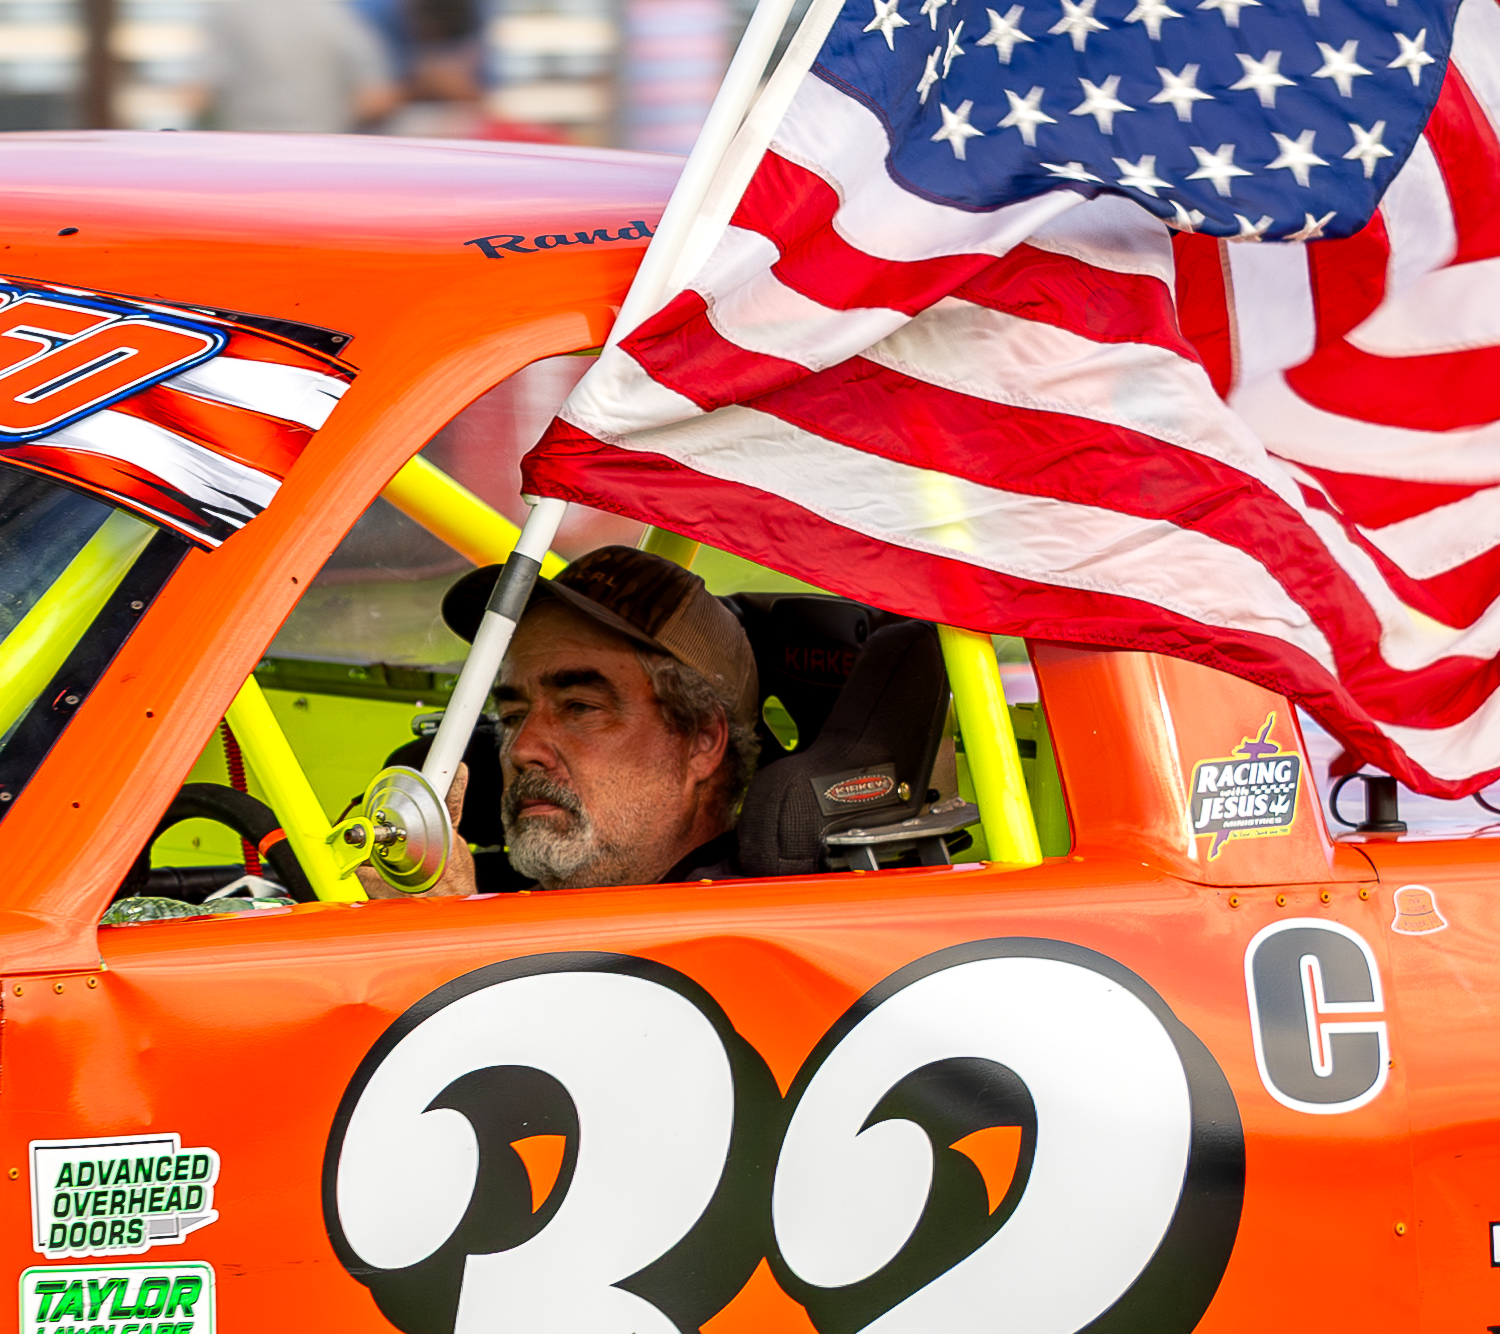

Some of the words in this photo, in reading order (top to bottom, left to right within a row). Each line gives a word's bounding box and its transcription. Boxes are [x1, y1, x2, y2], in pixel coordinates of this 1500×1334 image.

[463, 220, 660, 259] Rand
[784, 646, 855, 677] KIRKE
[1196, 759, 1292, 794] RACING
[1219, 786, 1250, 798] with
[1194, 793, 1269, 829] JESUS
[1222, 816, 1283, 829] MINISTRIES
[1244, 918, 1389, 1114] C
[54, 1153, 211, 1189] ADVANCED
[53, 1184, 204, 1218] OVERHEAD
[47, 1218, 145, 1249] DOORS
[34, 1275, 203, 1323] TAYLOR
